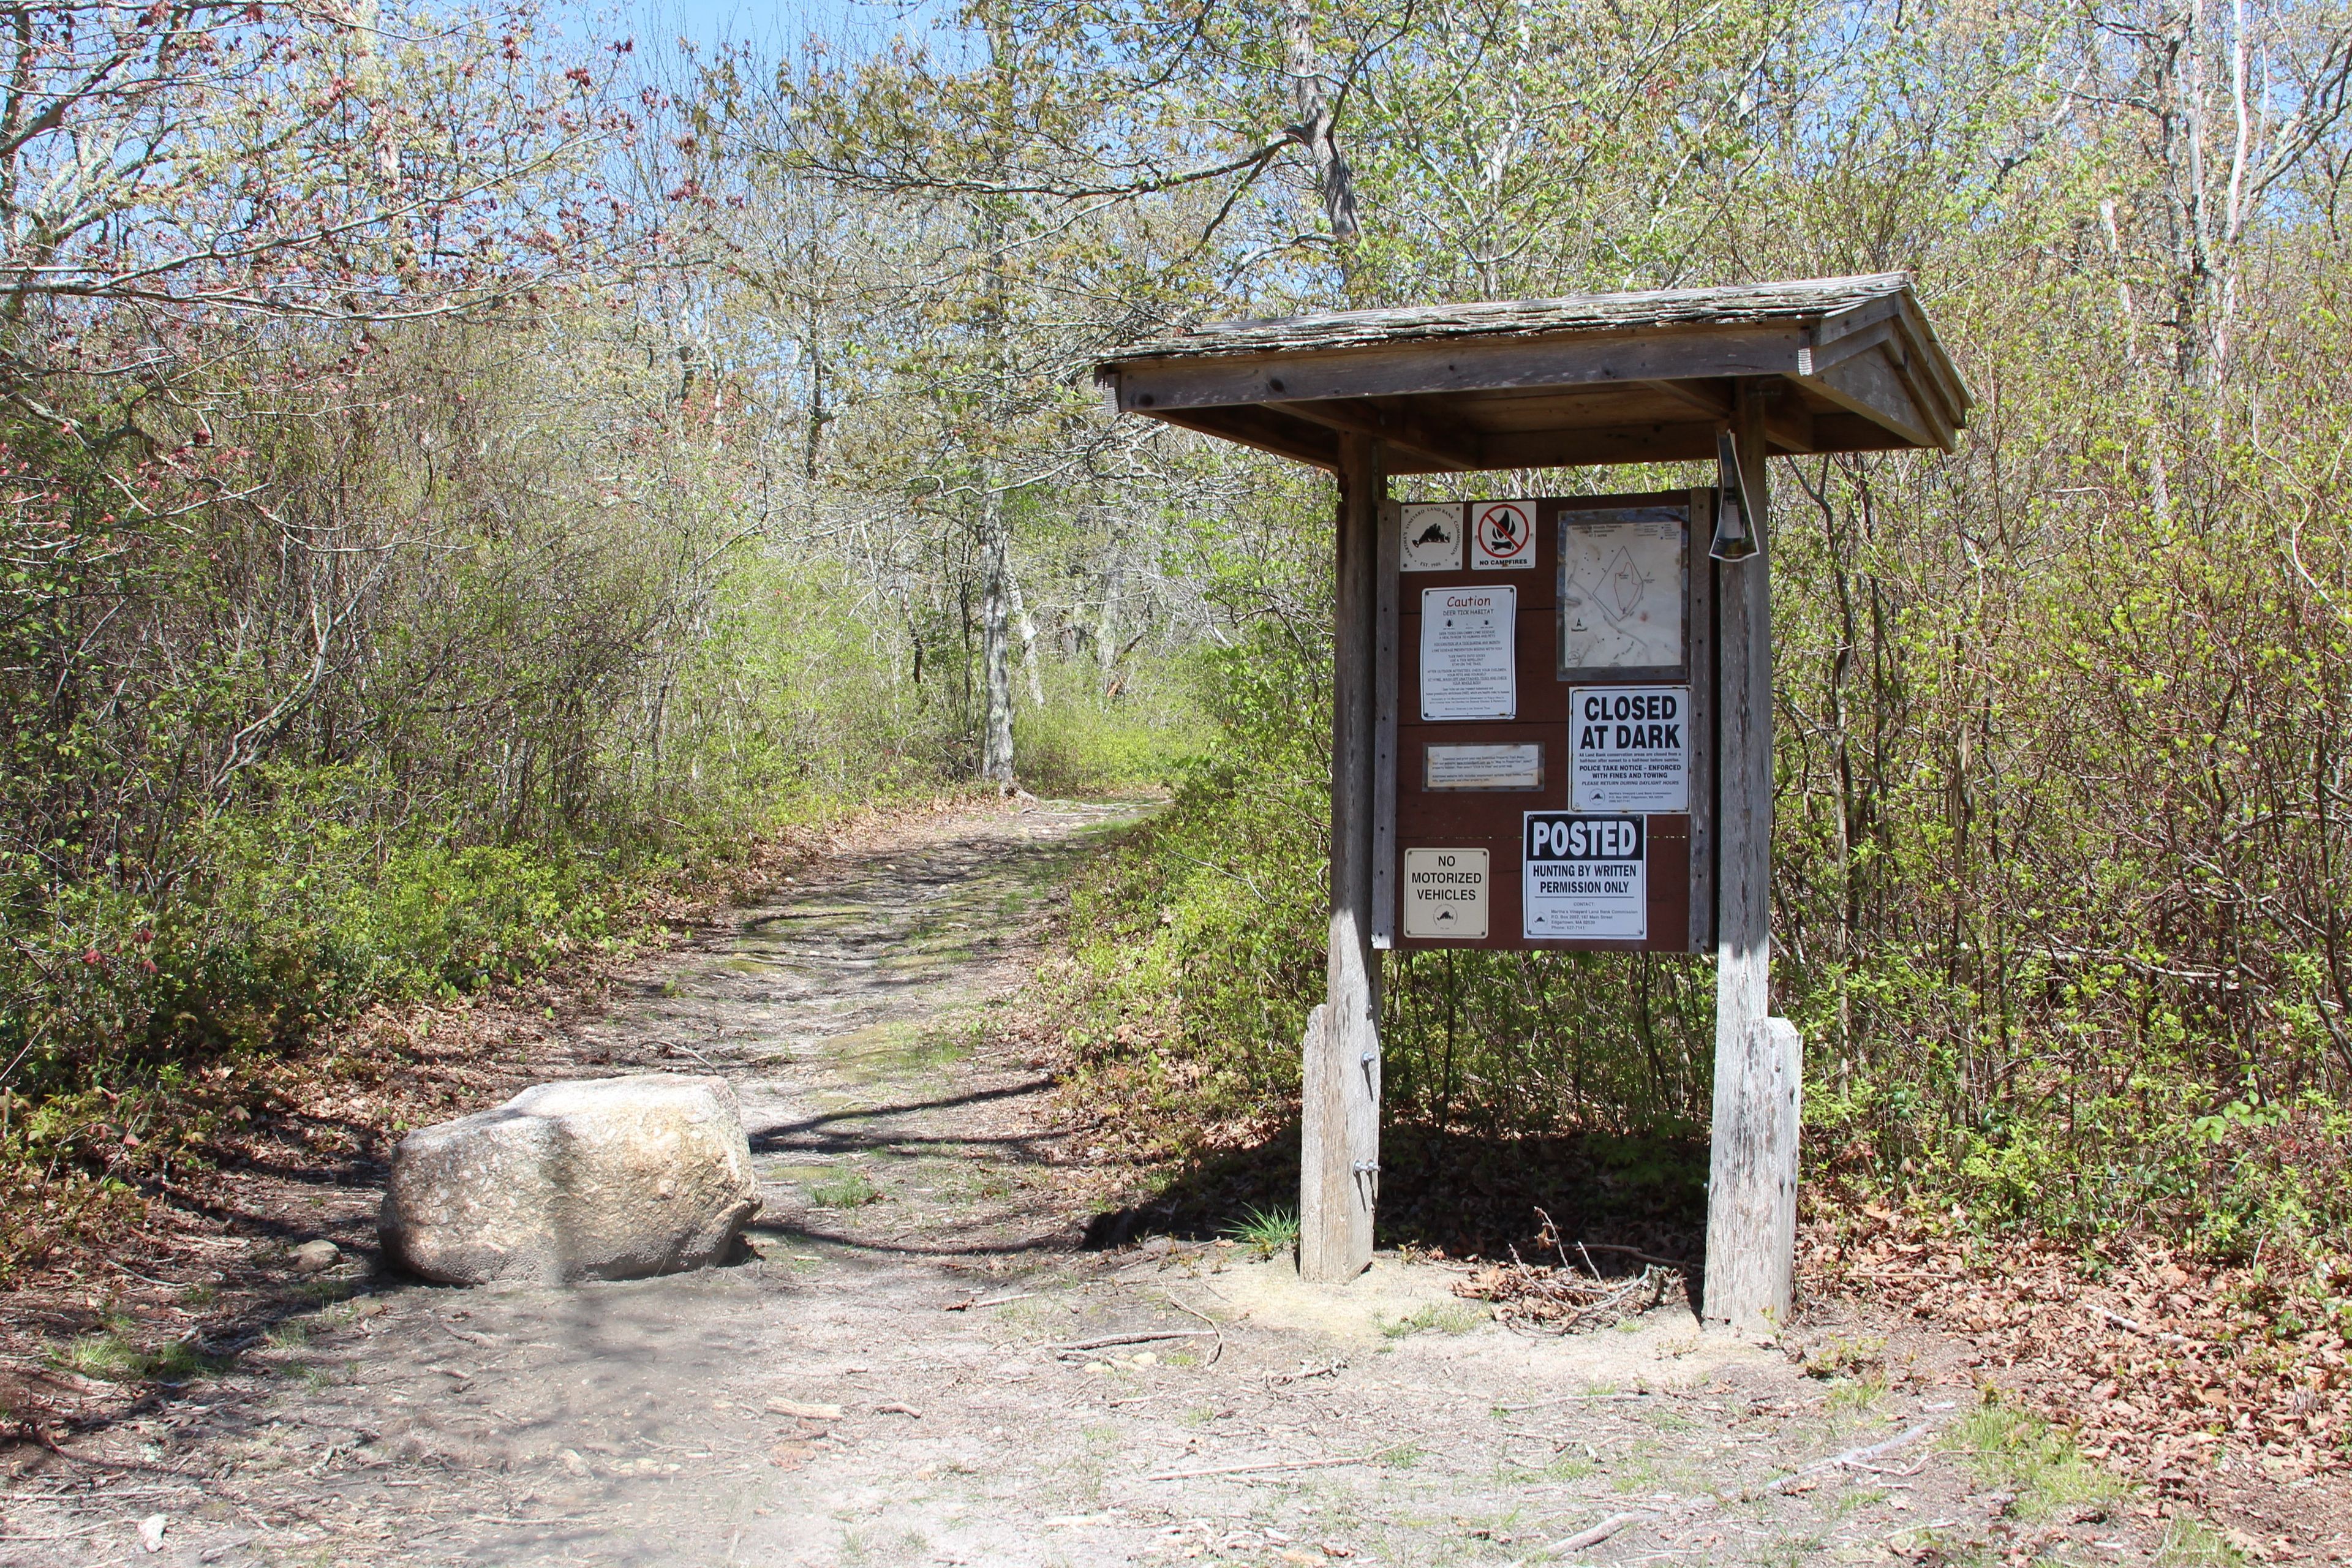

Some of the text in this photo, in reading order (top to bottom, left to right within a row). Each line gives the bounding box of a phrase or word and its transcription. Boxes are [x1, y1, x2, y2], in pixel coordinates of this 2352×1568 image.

[1406, 509, 1425, 529] VINEYARD
[1442, 509, 1454, 519] BANK
[1447, 595, 1491, 607] Caution
[1585, 695, 1677, 721] CLOSED
[1580, 724, 1681, 749] AT DARK
[1533, 821, 1637, 856] POSTED
[1438, 856, 1455, 867] NO
[1533, 865, 1637, 876] HUNTING BY WRITTEN
[1412, 872, 1482, 883] MOTORIZED
[1540, 881, 1629, 893] PERMISSION ONLY
[1417, 889, 1476, 900] VEHICLES
